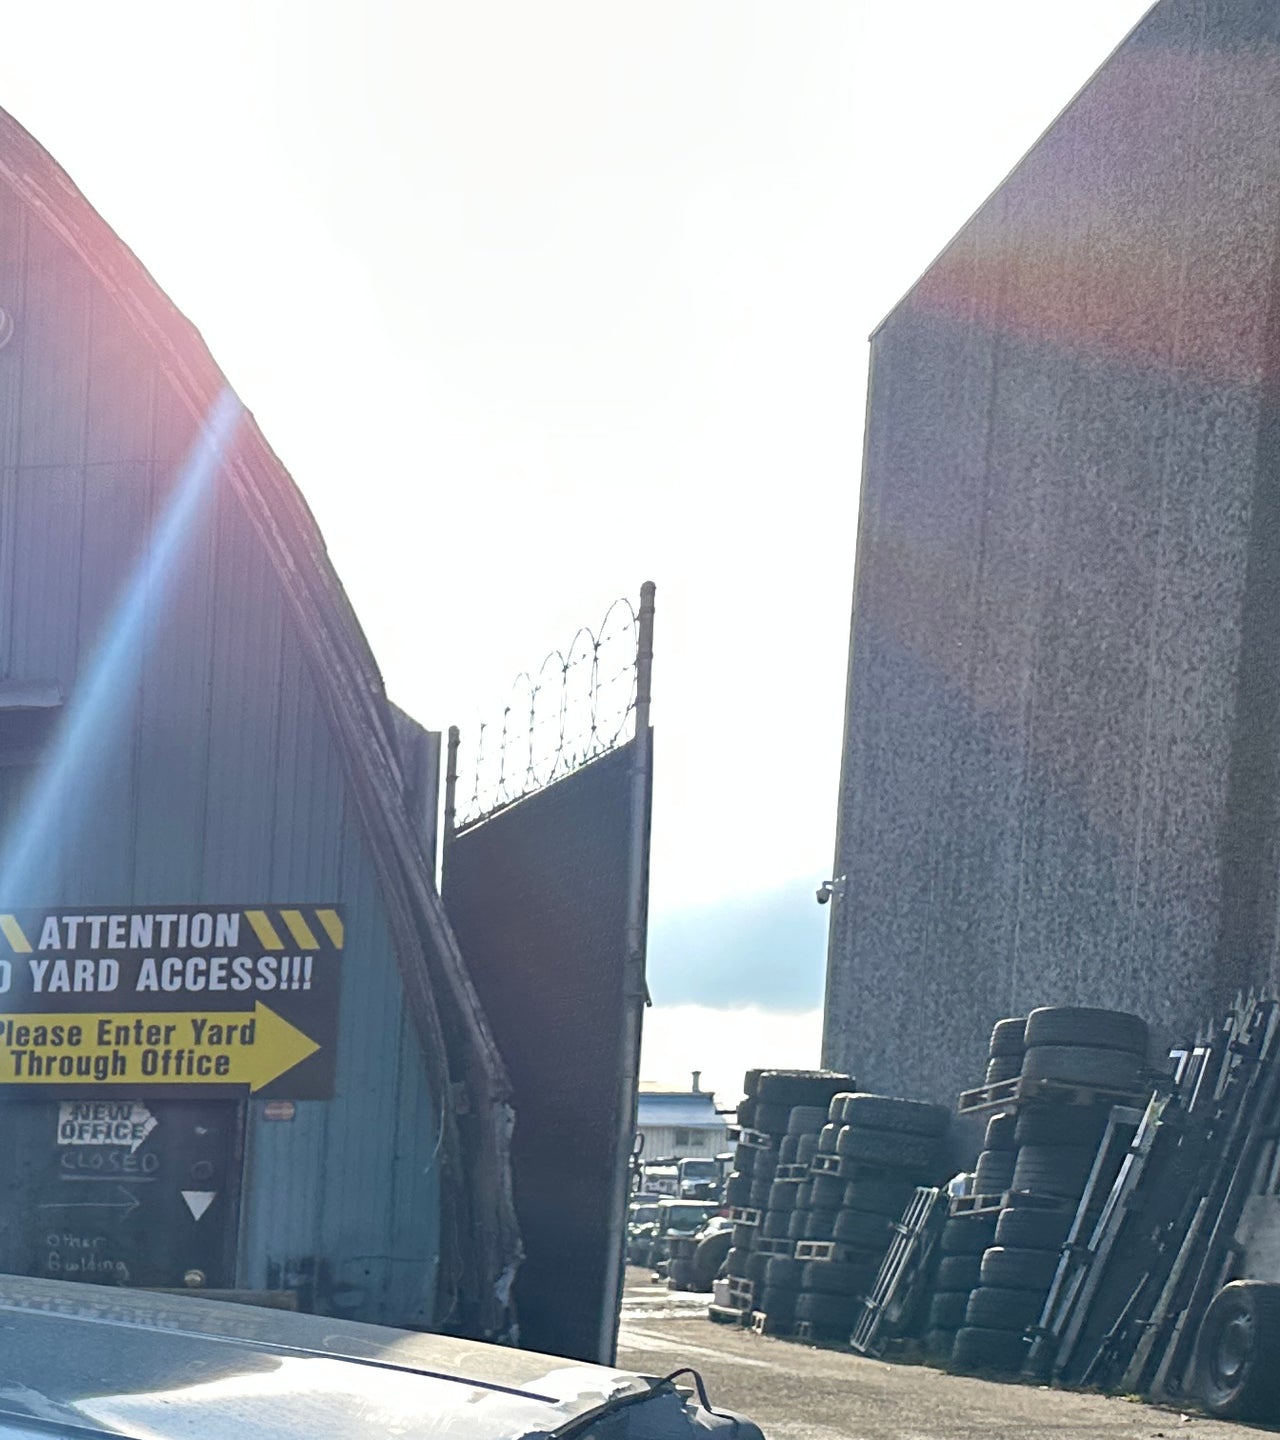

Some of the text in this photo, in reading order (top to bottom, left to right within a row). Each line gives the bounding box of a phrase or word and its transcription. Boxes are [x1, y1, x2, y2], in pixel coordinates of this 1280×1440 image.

[39, 912, 240, 949] ATTENTION
[30, 958, 119, 993] YARD
[136, 956, 313, 992] ACCESS!!!
[97, 1019, 176, 1046] Enter
[192, 1018, 255, 1046] Yard
[10, 1049, 230, 1081] Through Office
[71, 1102, 134, 1121] NEW
[60, 1121, 146, 1141] OFFICE
[60, 1152, 159, 1174] CLOSED
